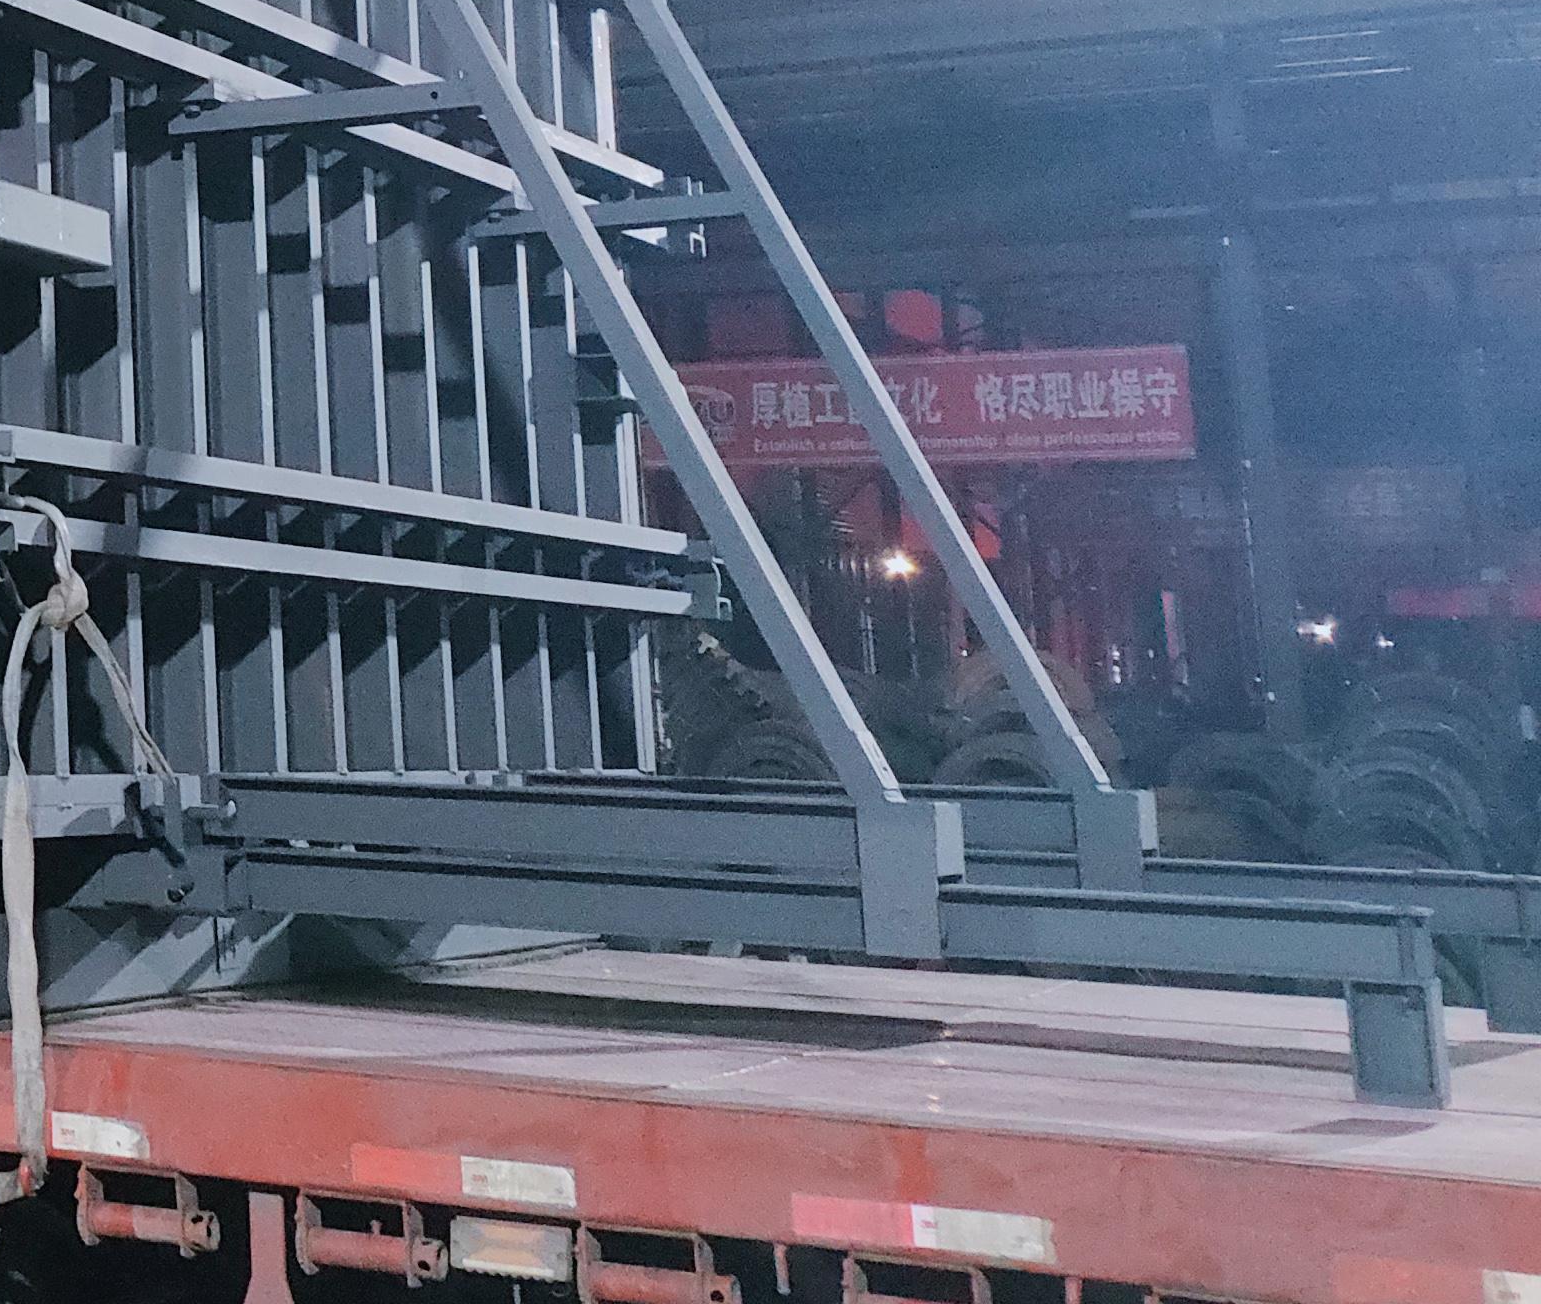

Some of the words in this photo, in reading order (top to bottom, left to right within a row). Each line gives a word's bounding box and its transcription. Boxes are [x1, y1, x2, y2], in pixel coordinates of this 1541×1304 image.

[751, 377, 943, 430] 厚植工文化
[974, 367, 1179, 423] 恪尽职业操守
